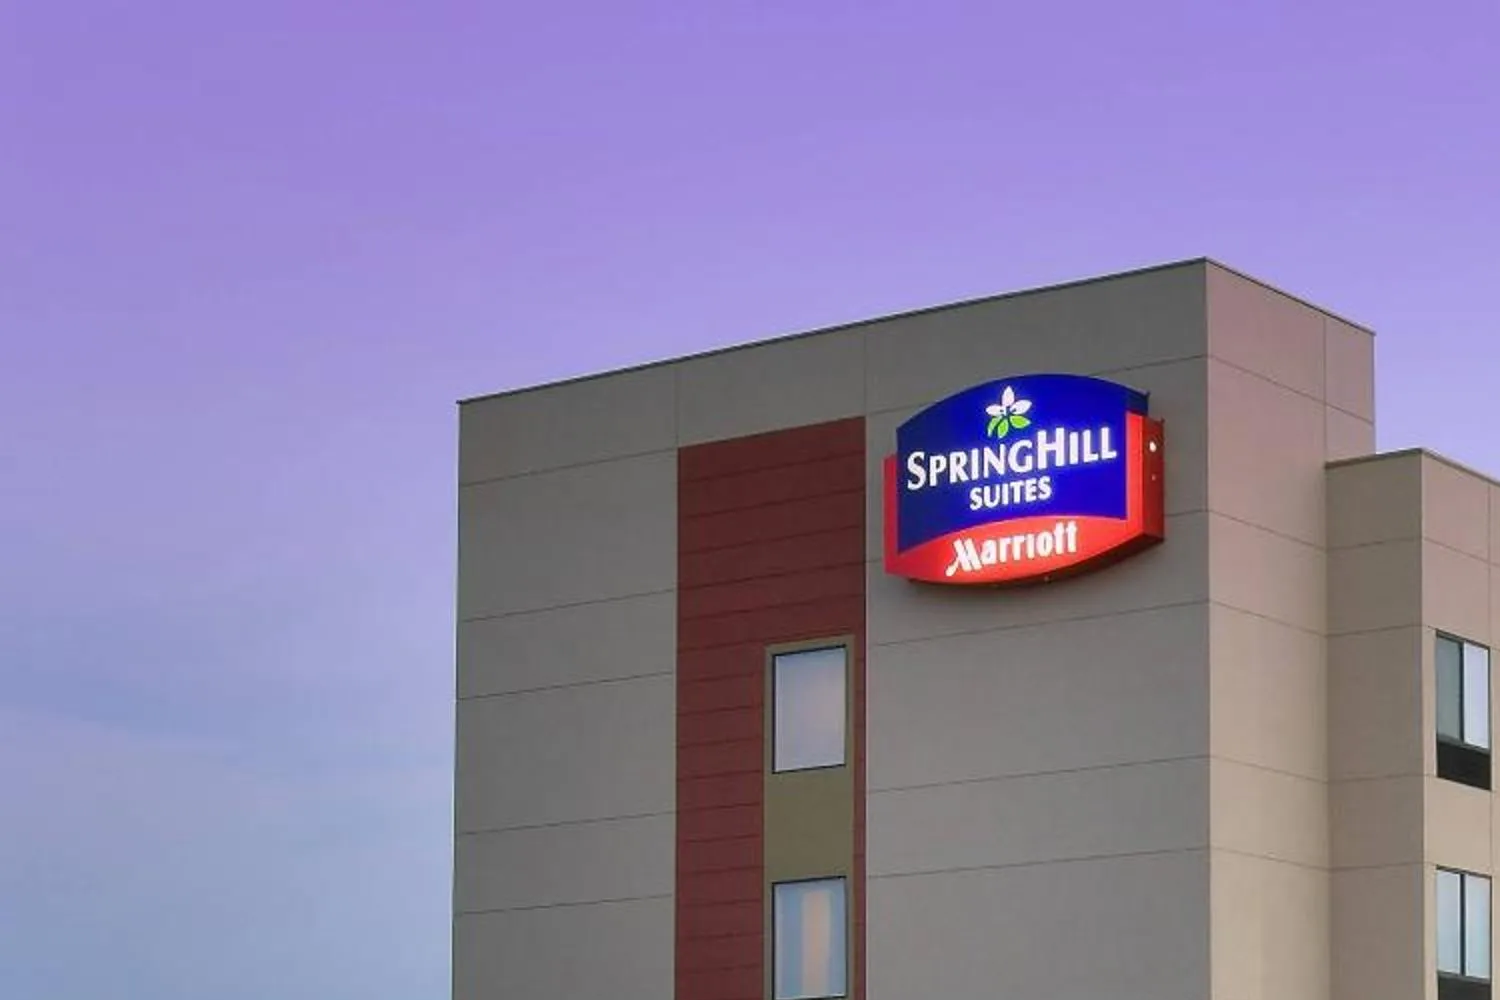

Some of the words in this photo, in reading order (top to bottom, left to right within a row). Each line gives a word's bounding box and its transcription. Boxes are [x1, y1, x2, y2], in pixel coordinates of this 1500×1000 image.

[906, 426, 1118, 491] SPRINGHILL
[969, 475, 1053, 511] SUITES
[945, 519, 1079, 577] Marriott
